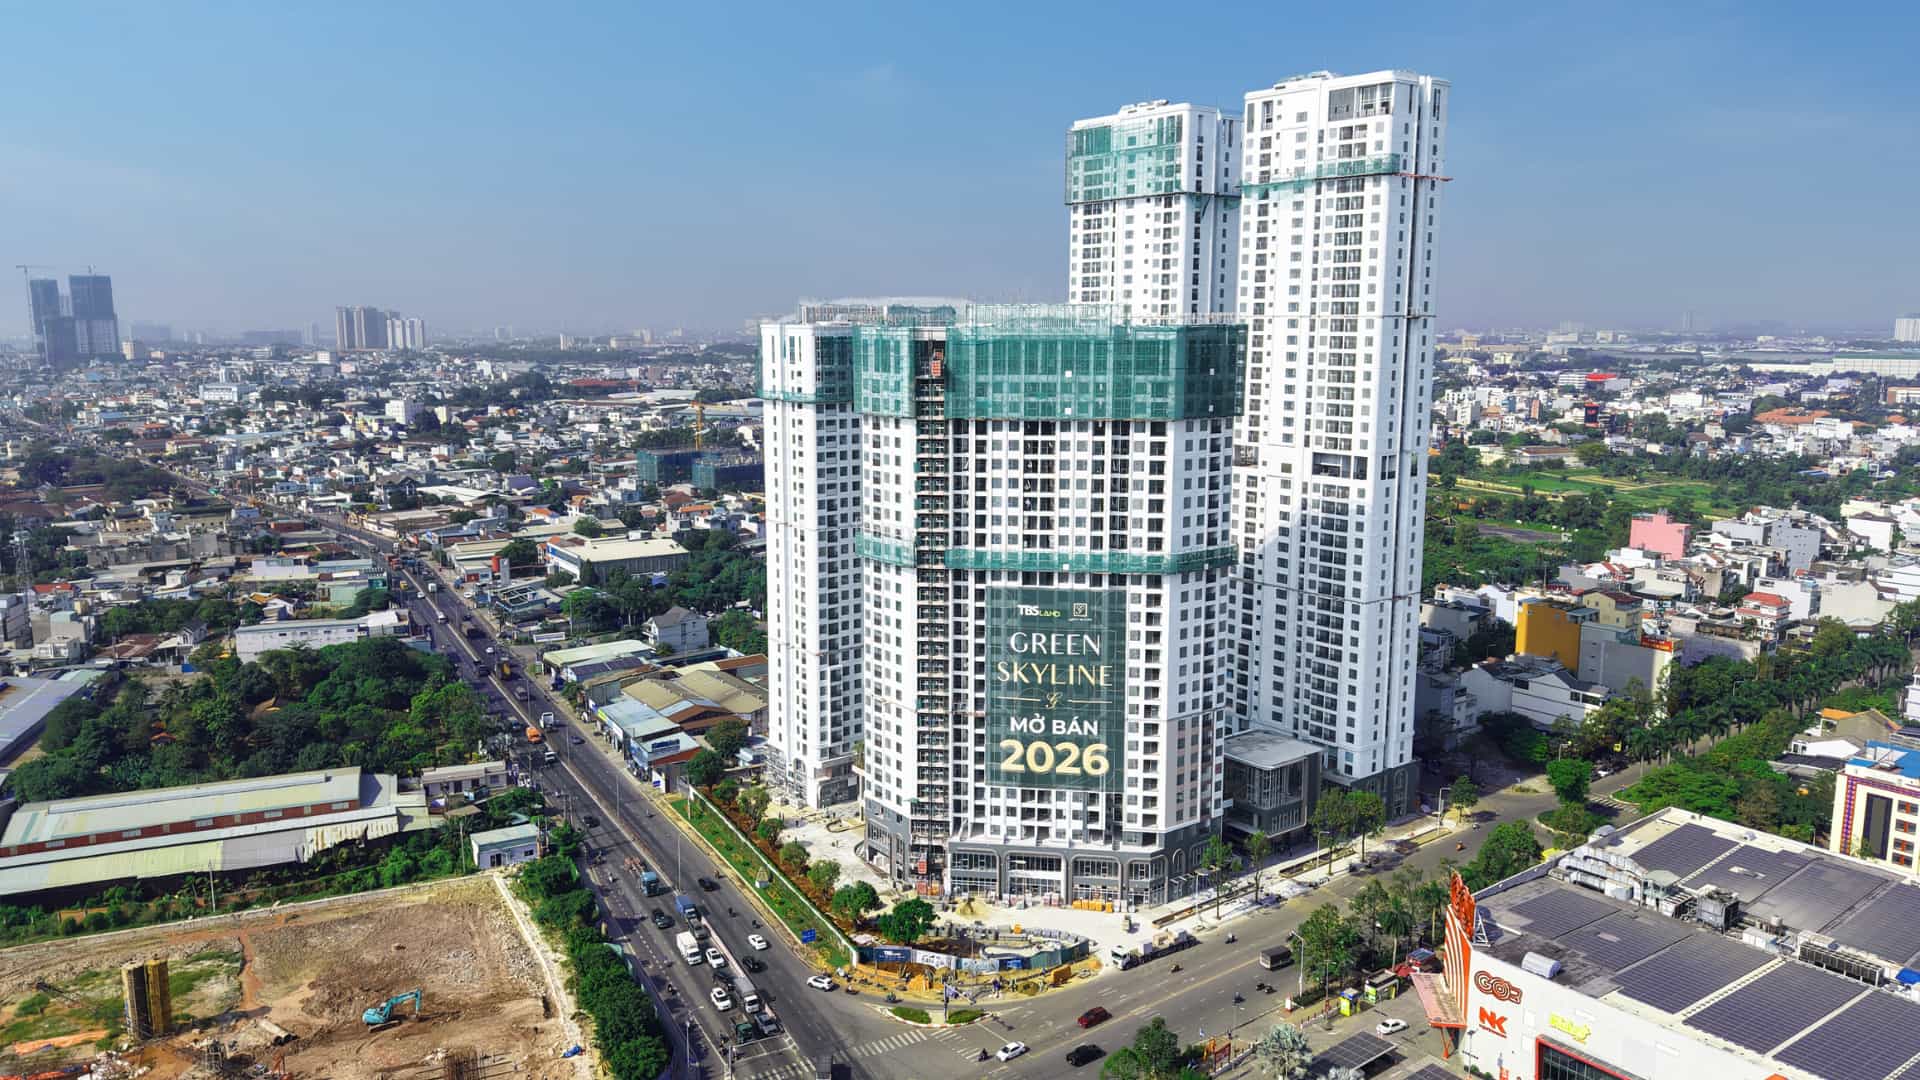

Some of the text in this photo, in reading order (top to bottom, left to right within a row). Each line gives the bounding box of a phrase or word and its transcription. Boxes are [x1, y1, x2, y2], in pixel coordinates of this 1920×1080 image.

[1010, 631, 1101, 656] GREEN
[997, 660, 1113, 687] SKYLINE
[1010, 712, 1099, 736] MỞ BÁN
[999, 738, 1110, 776] 2026
[1479, 1006, 1507, 1034] NK
